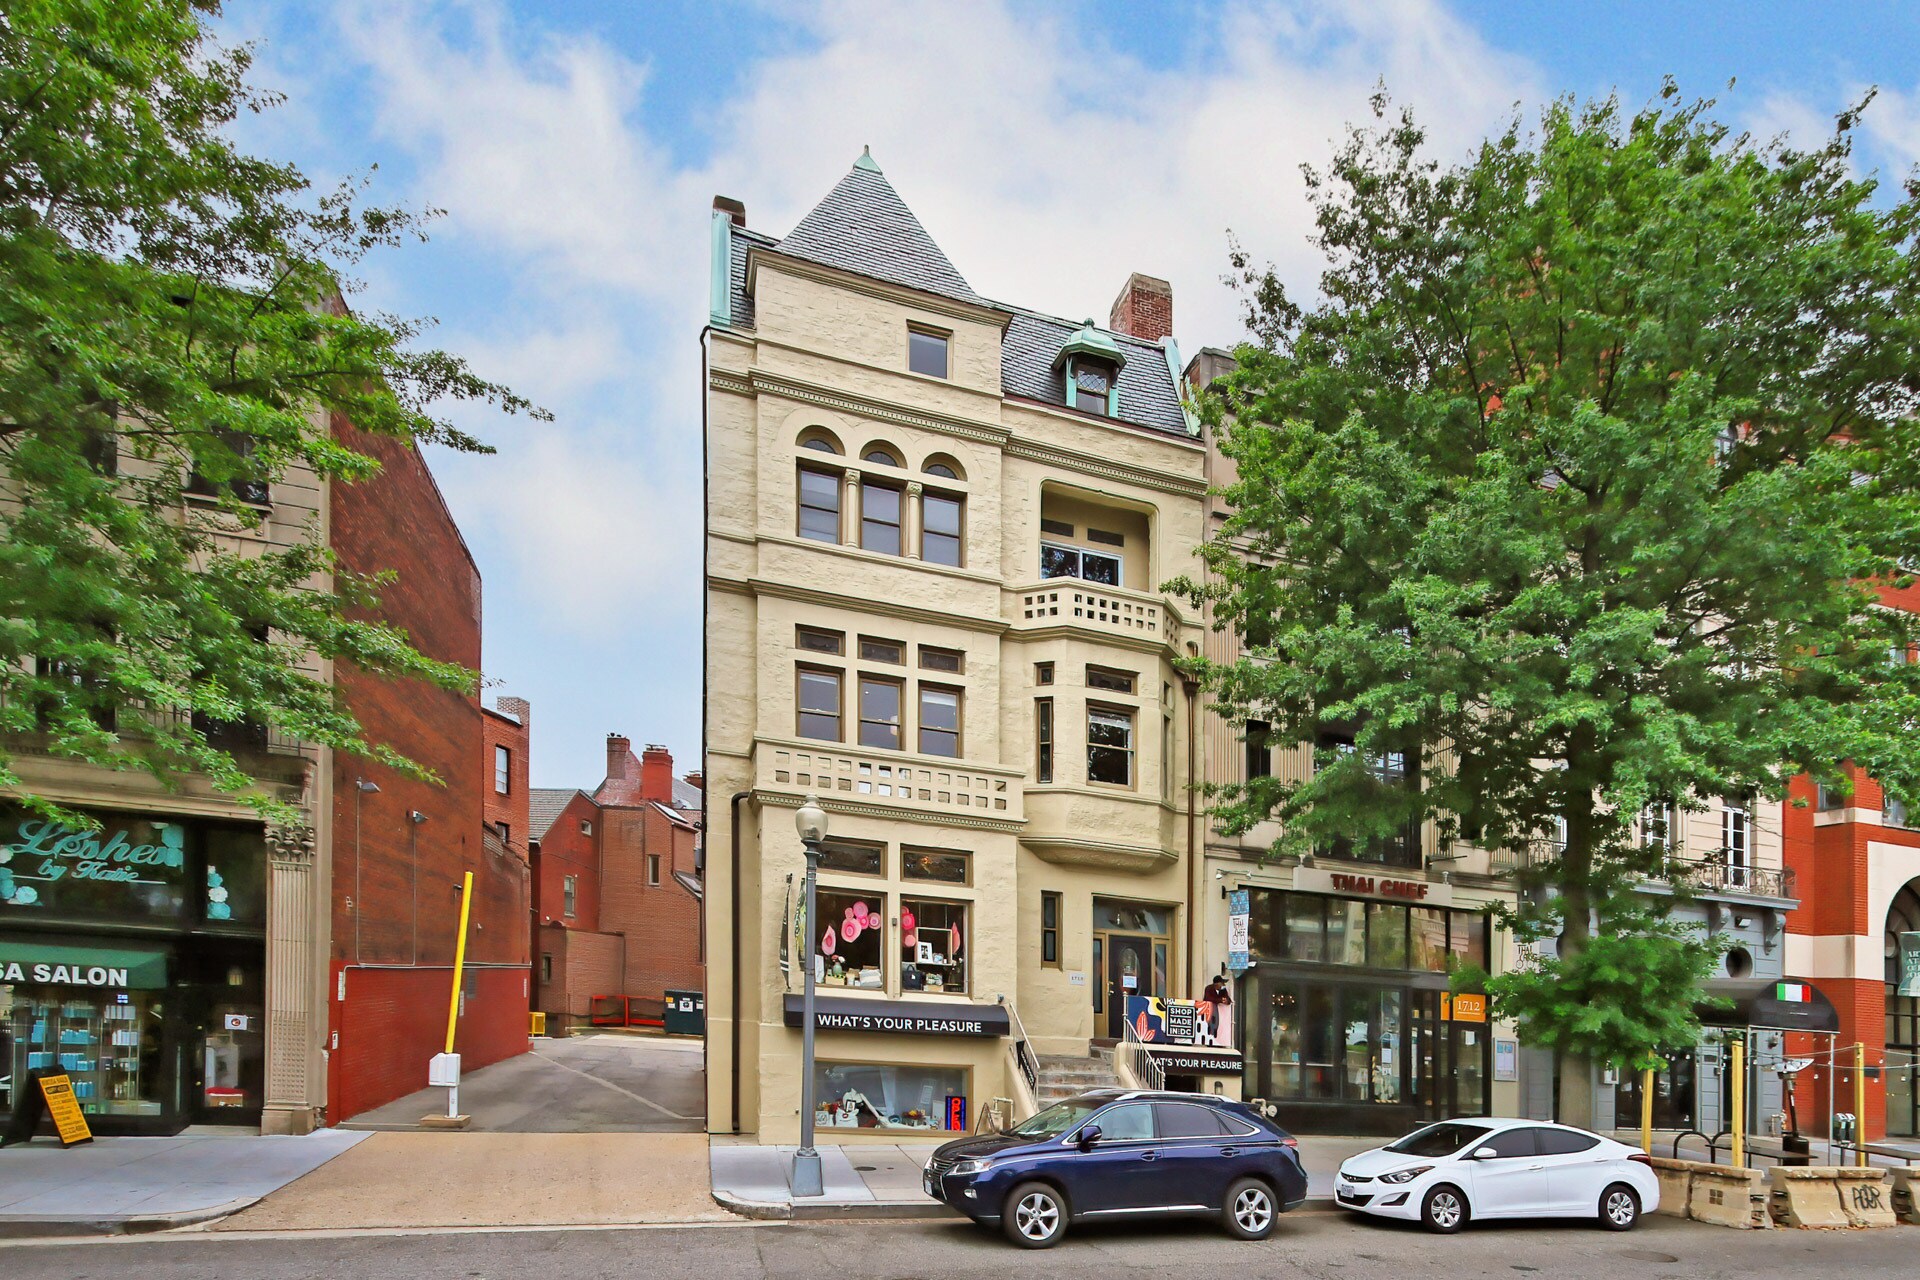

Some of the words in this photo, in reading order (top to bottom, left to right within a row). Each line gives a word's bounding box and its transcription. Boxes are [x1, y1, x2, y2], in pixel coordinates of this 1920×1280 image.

[37, 858, 67, 881] by
[71, 860, 139, 882] Katie
[1330, 873, 1375, 894] THAI
[1380, 879, 1429, 900] CHEF
[33, 963, 128, 987] SALON
[1170, 1007, 1192, 1015] SHOP
[1458, 1000, 1480, 1011] 1712
[817, 1014, 871, 1028] WHAT'S
[874, 1017, 912, 1030] YOUR
[916, 1019, 982, 1033] PLEASURE
[1170, 1017, 1192, 1026] MADE
[1170, 1027, 1177, 1035] IN
[1180, 1028, 1192, 1036] DC
[1175, 1058, 1199, 1068] YOUR
[1201, 1060, 1242, 1070] PLEASURE
